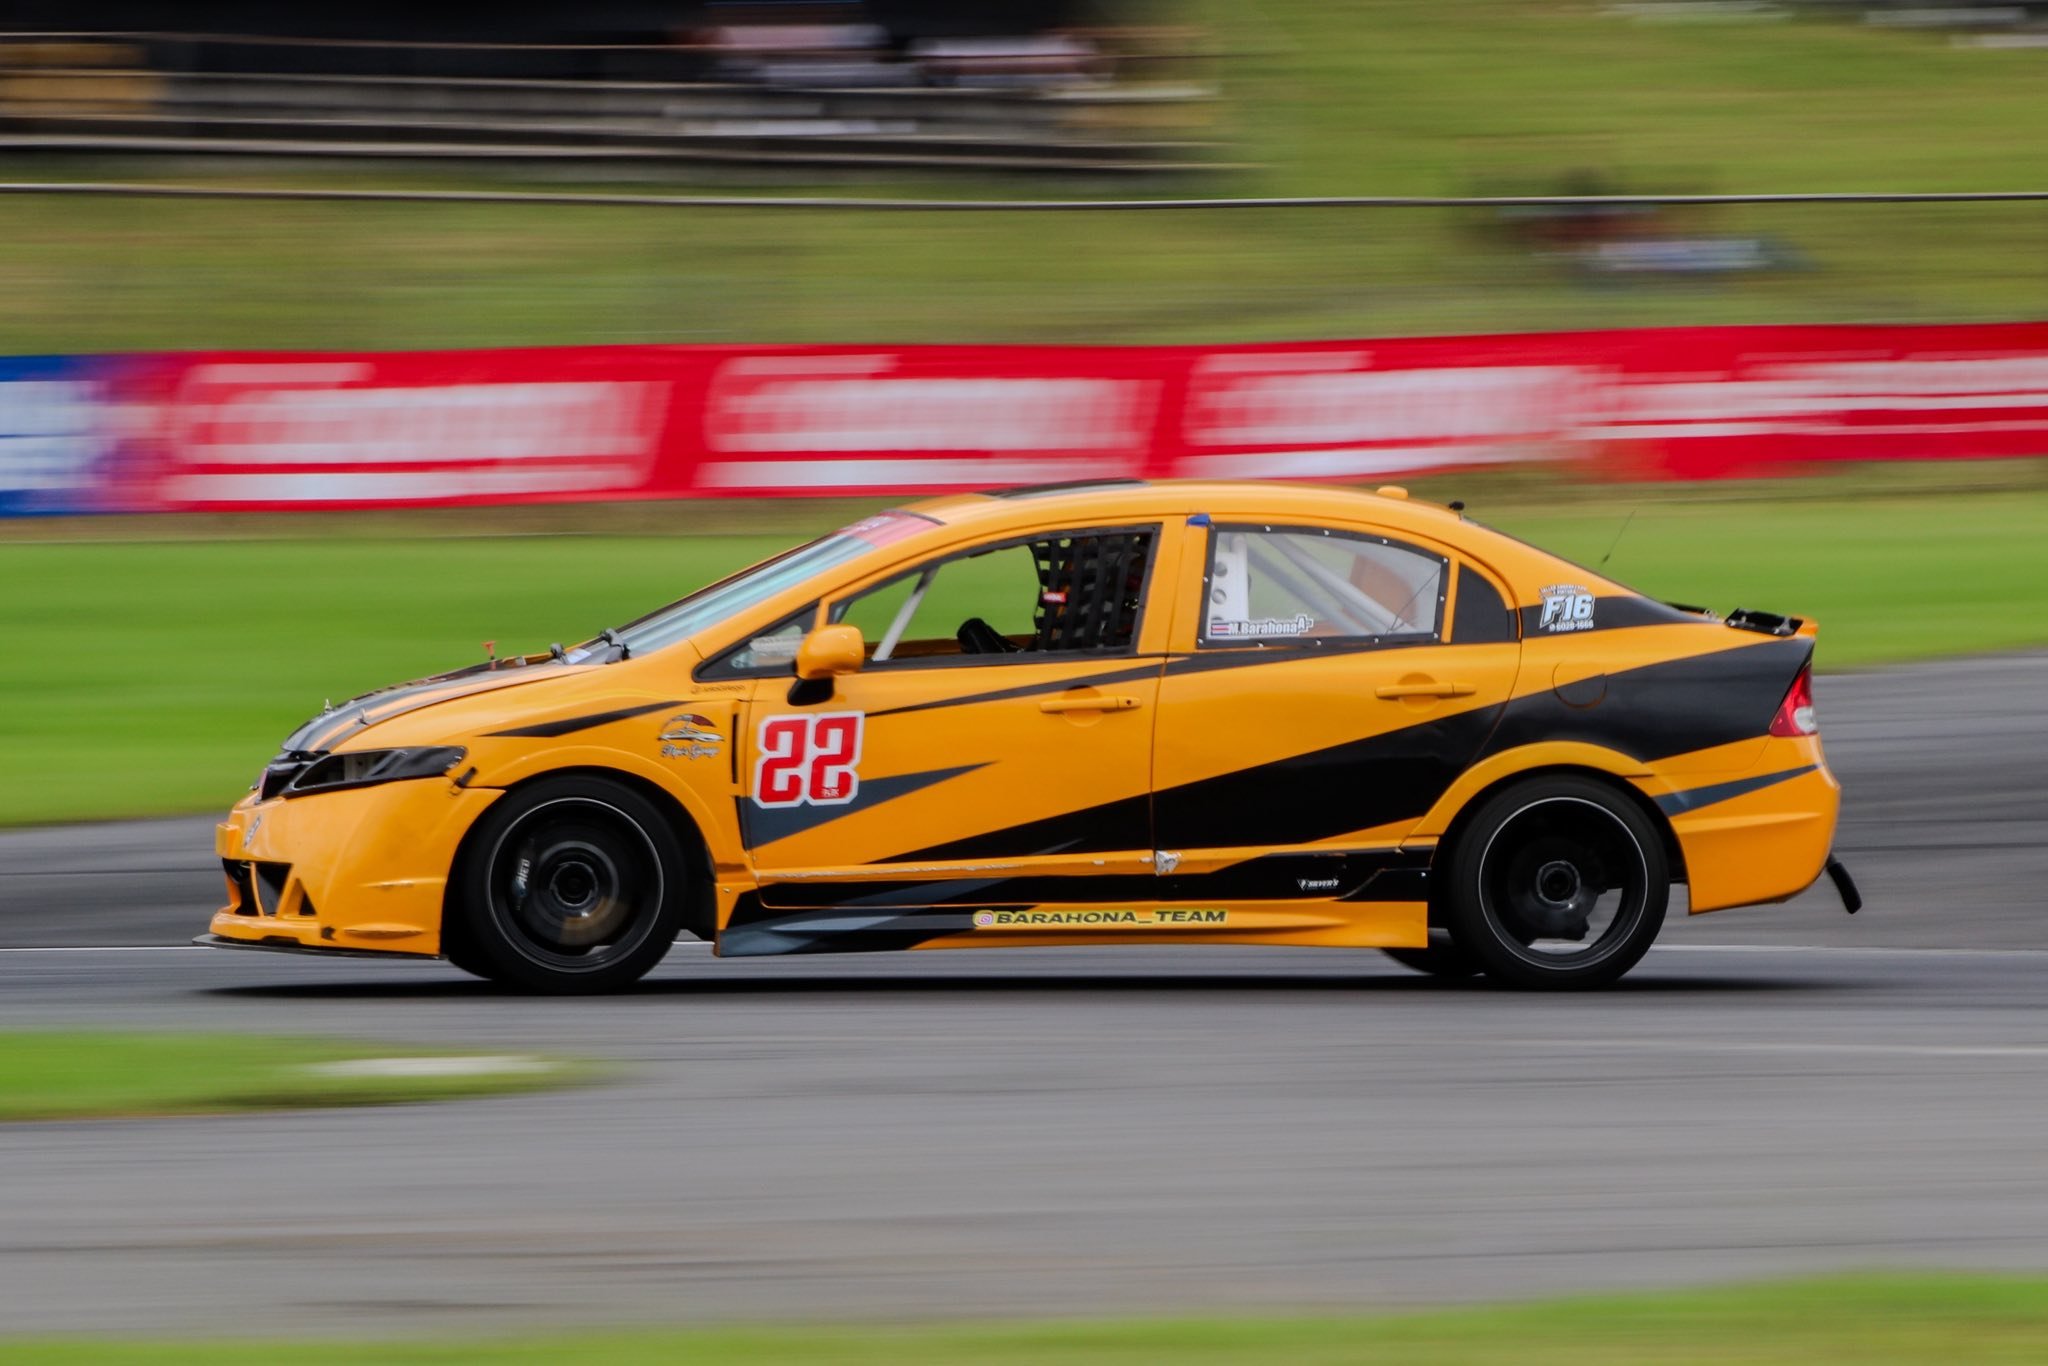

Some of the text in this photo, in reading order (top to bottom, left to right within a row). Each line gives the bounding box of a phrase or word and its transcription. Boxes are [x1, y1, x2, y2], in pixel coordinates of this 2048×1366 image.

[1542, 594, 1594, 625] F16
[757, 714, 861, 806] 22
[996, 910, 1226, 925] BARAHONA_TEAM
